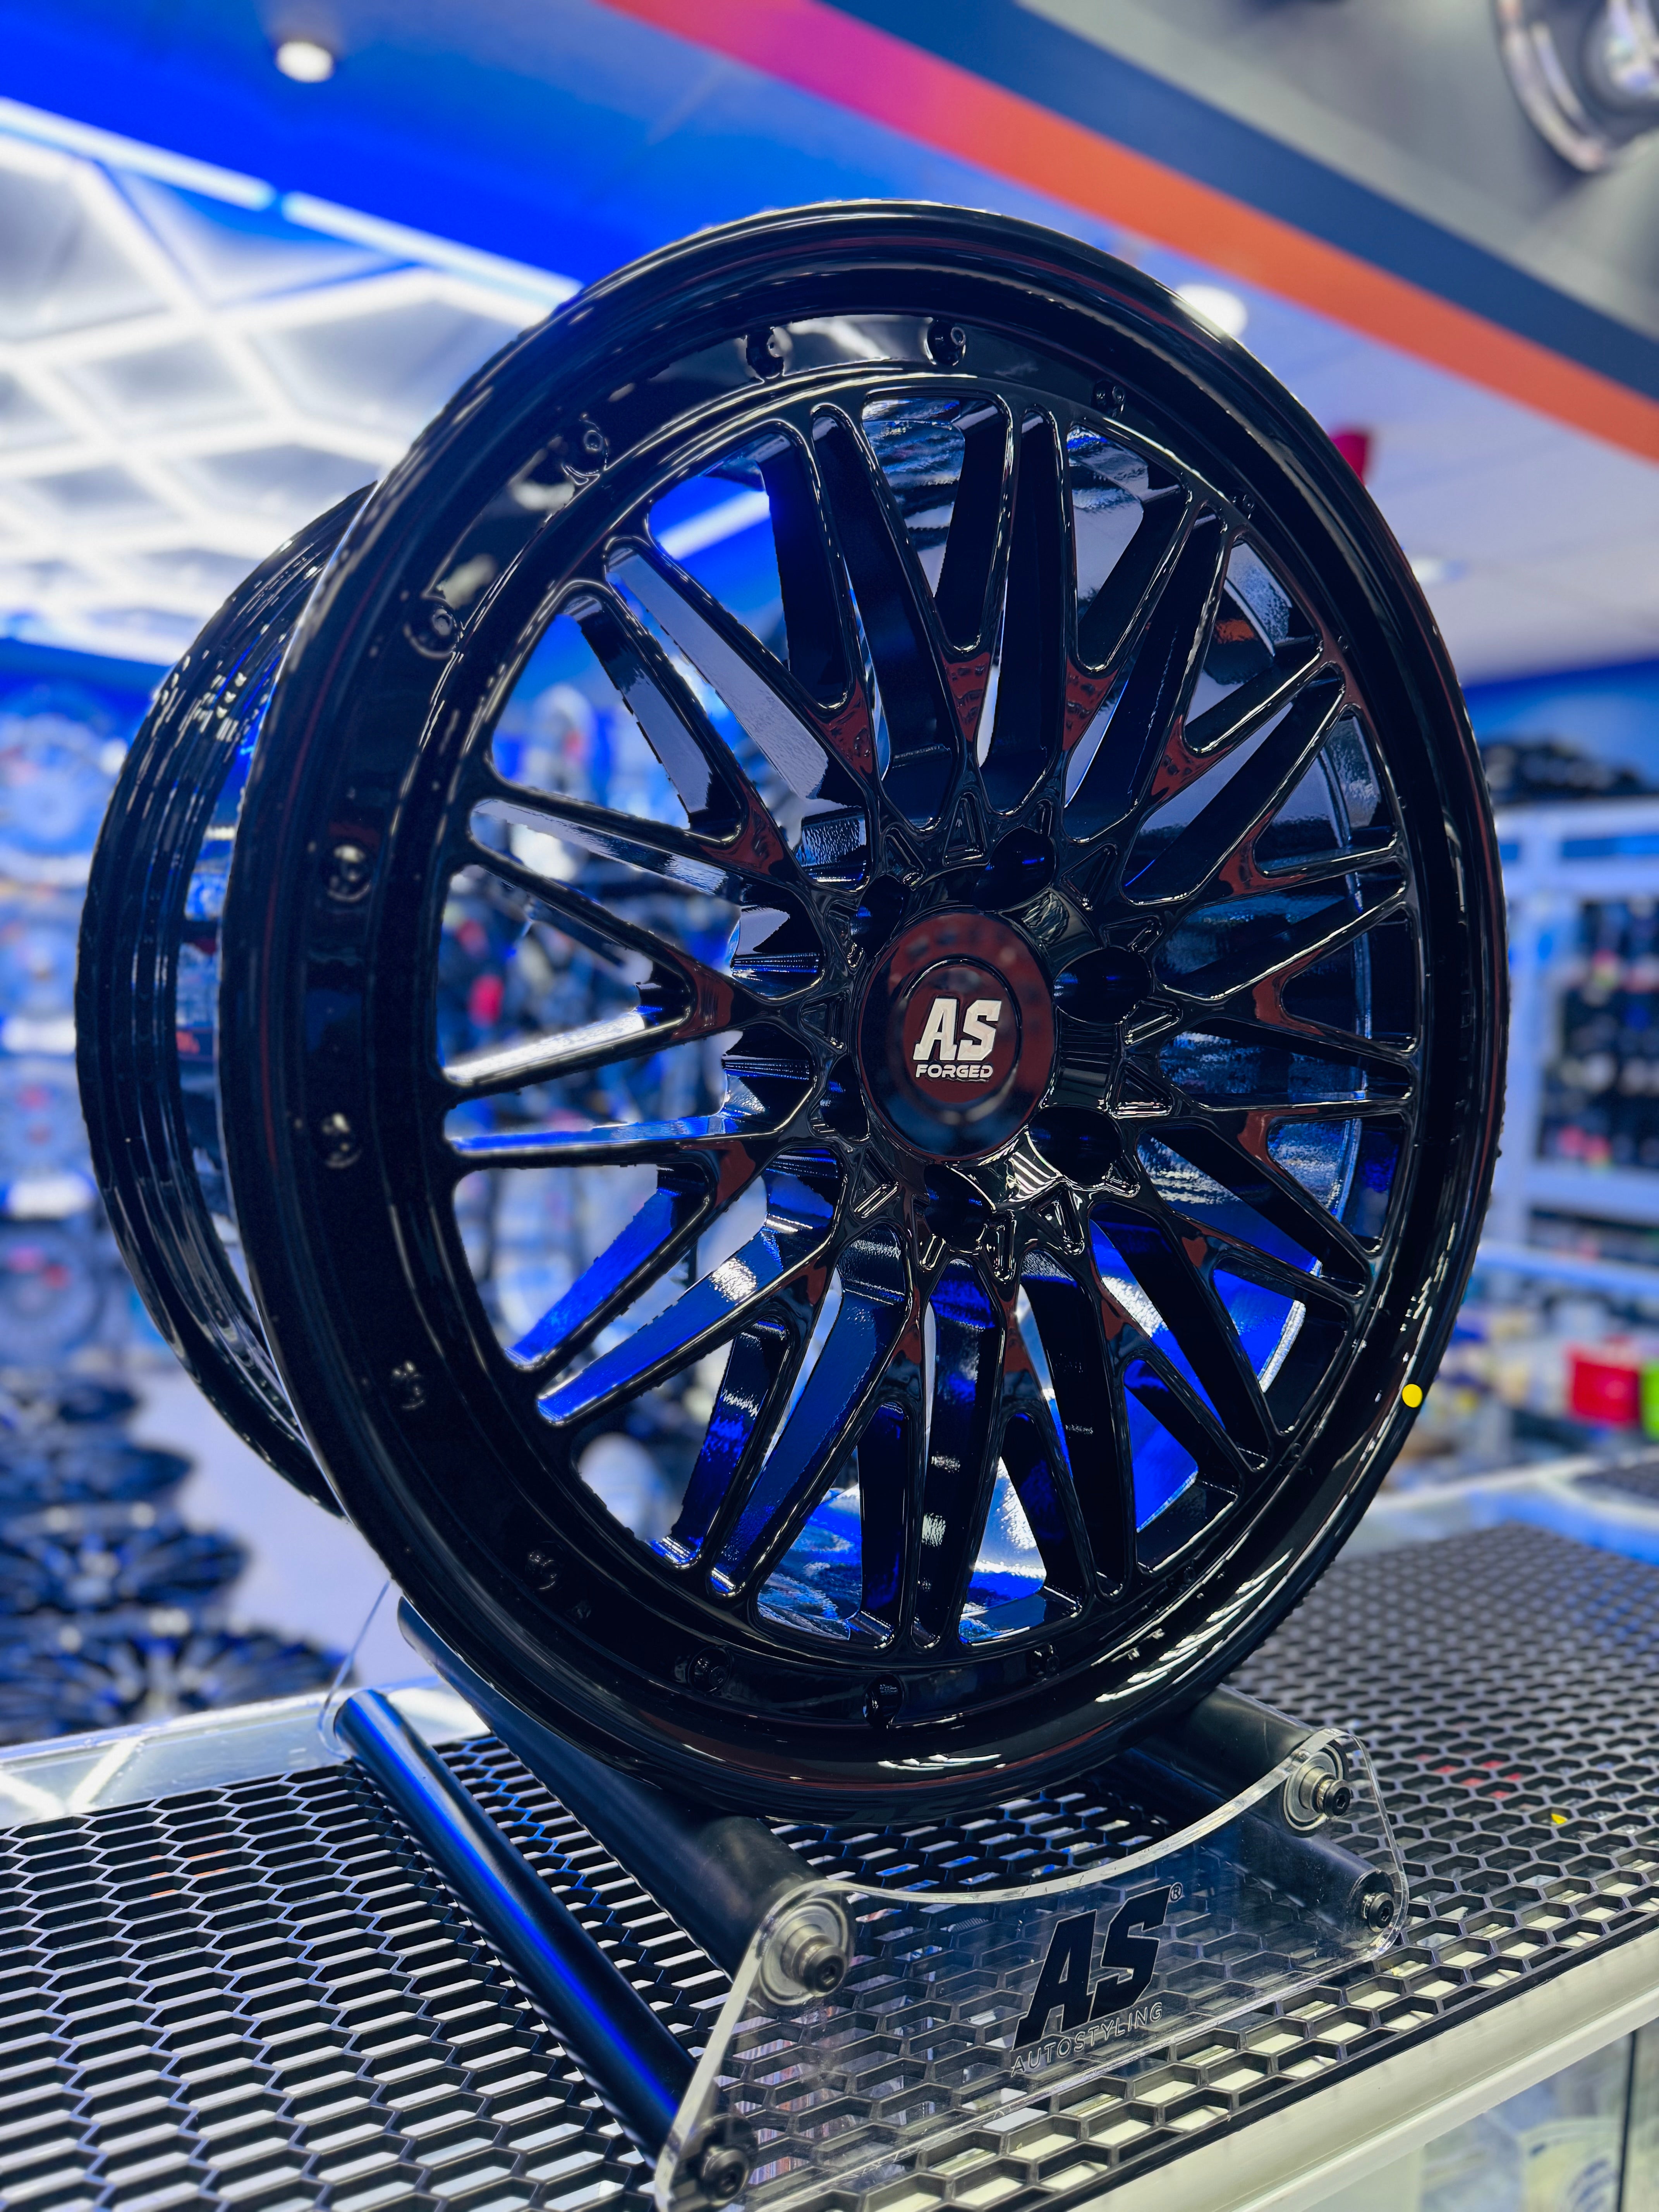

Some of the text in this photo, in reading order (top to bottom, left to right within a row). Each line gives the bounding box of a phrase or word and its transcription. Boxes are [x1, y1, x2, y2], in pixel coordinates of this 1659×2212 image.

[913, 998, 1001, 1061] AS
[916, 1064, 993, 1078] FORGED
[1011, 2002, 1163, 2078] AUTOSTYLING
